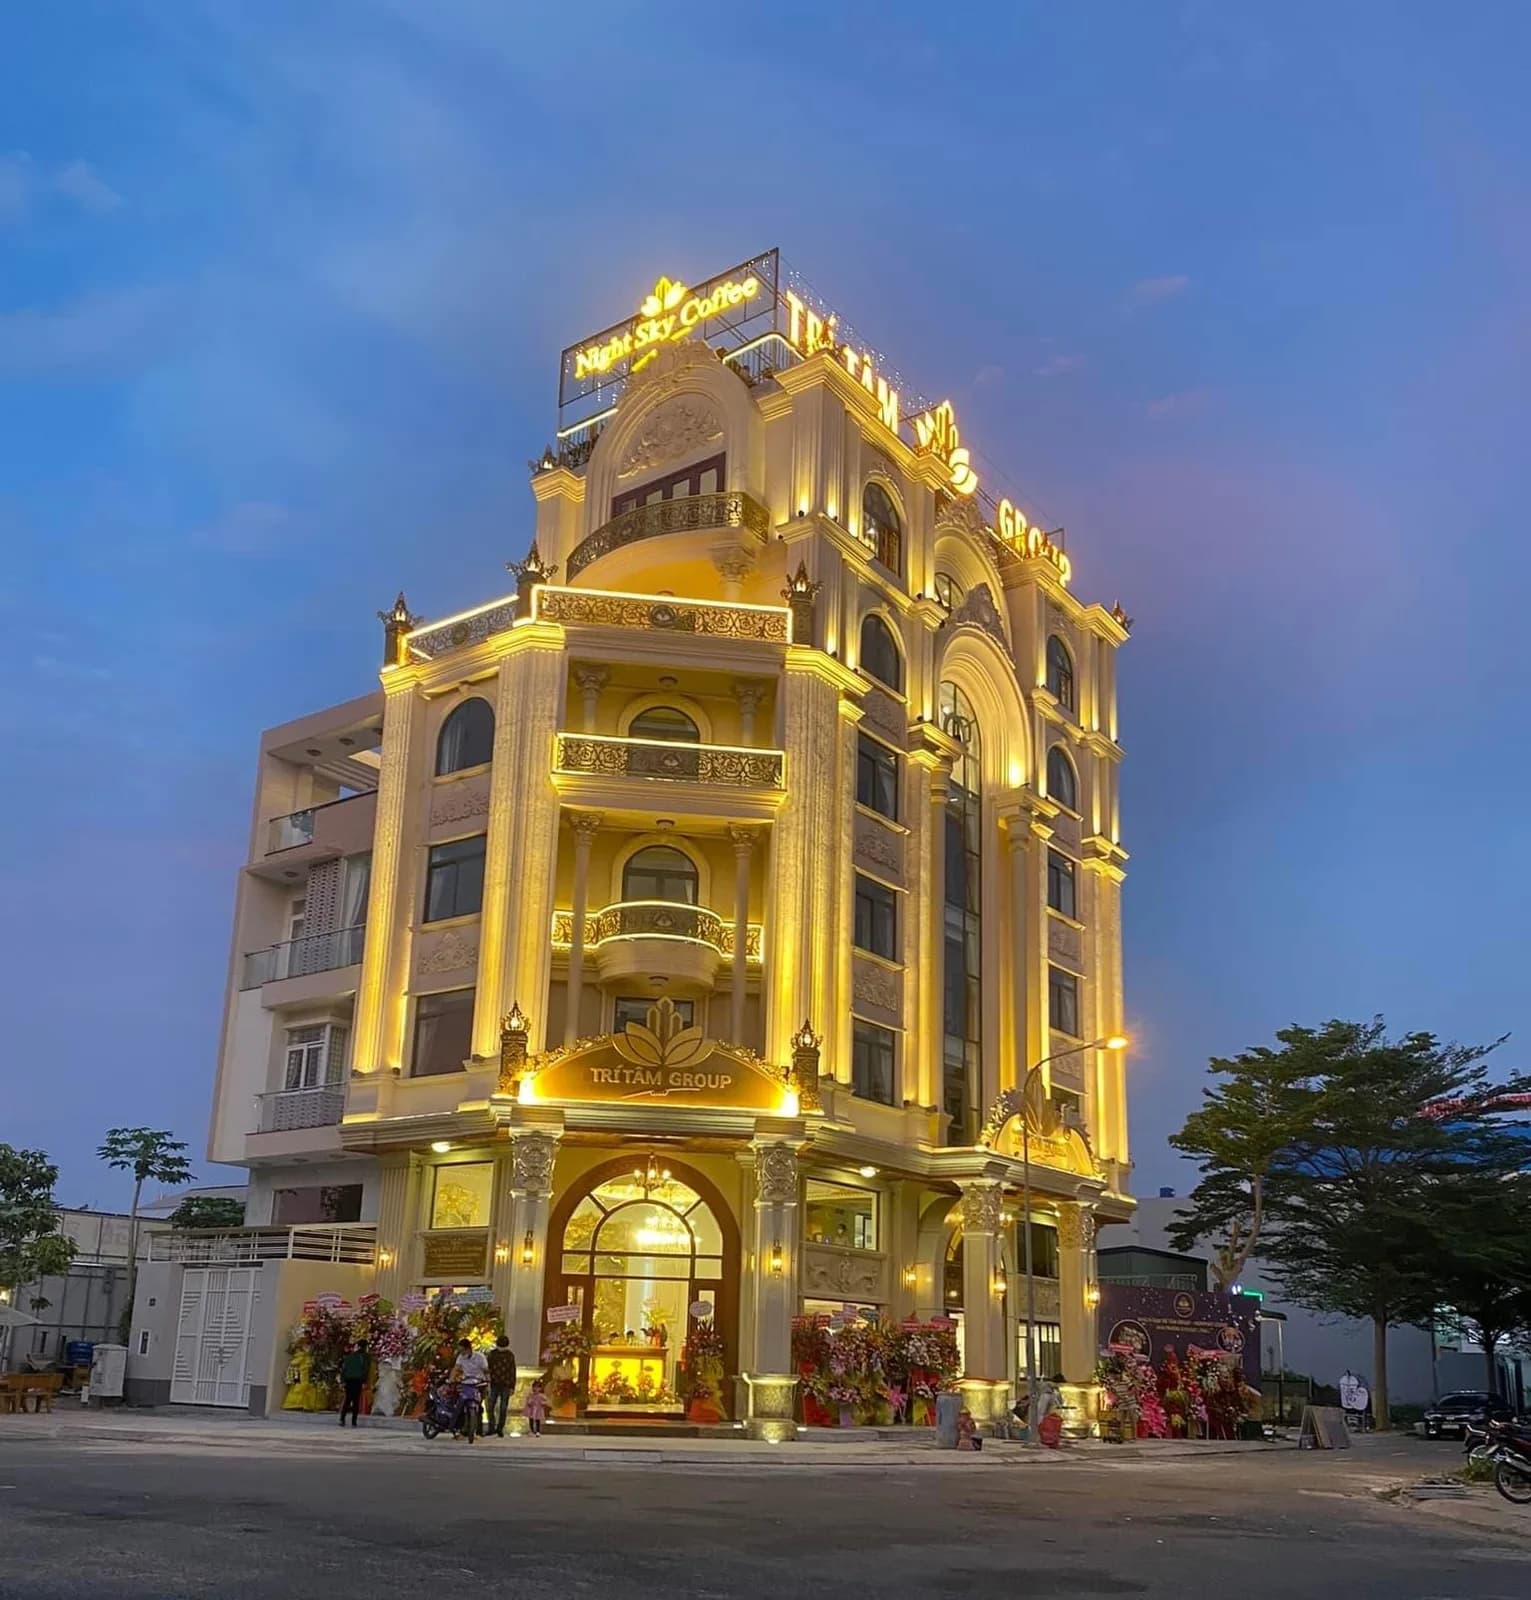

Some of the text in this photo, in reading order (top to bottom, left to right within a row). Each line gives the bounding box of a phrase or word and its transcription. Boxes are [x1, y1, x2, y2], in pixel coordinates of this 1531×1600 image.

[575, 276, 759, 379] Night Sky Coffee
[589, 1064, 732, 1089] TRÍ TÂM GROUP
